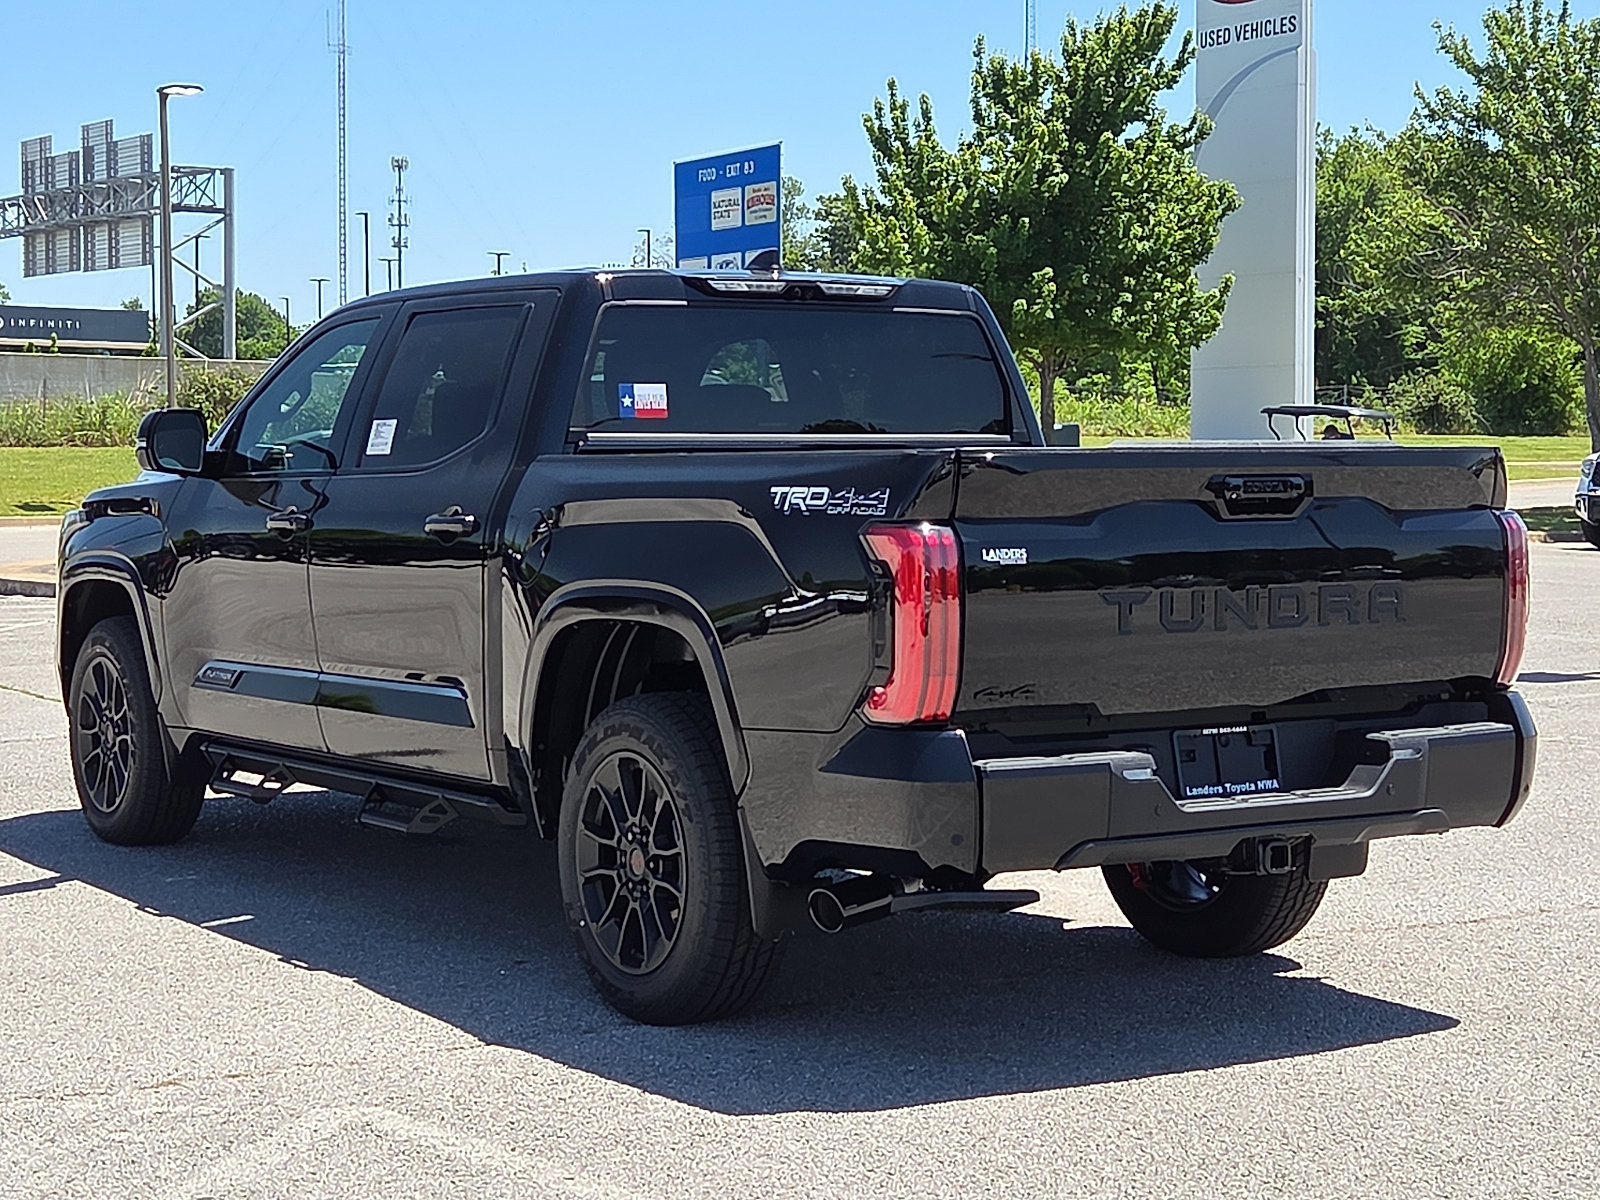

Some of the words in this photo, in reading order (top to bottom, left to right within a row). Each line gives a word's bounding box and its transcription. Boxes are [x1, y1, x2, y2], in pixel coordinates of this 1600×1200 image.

[1200, 28, 1231, 49] USED
[1234, 15, 1297, 42] VEHICLES
[698, 167, 717, 182] FOOD
[726, 162, 741, 178] EXIT
[743, 160, 754, 175] 83
[712, 197, 741, 210] NATURAL
[712, 209, 732, 221] STATE
[10, 317, 80, 329] INFINITI
[1245, 481, 1285, 492] TOYOTA
[770, 486, 831, 516] TRD
[981, 547, 1028, 562] LANDERS
[1102, 582, 1406, 636] TUNDRA
[1185, 785, 1223, 796] Landers
[1224, 781, 1256, 794] Toyota
[1257, 779, 1279, 790] NWA
